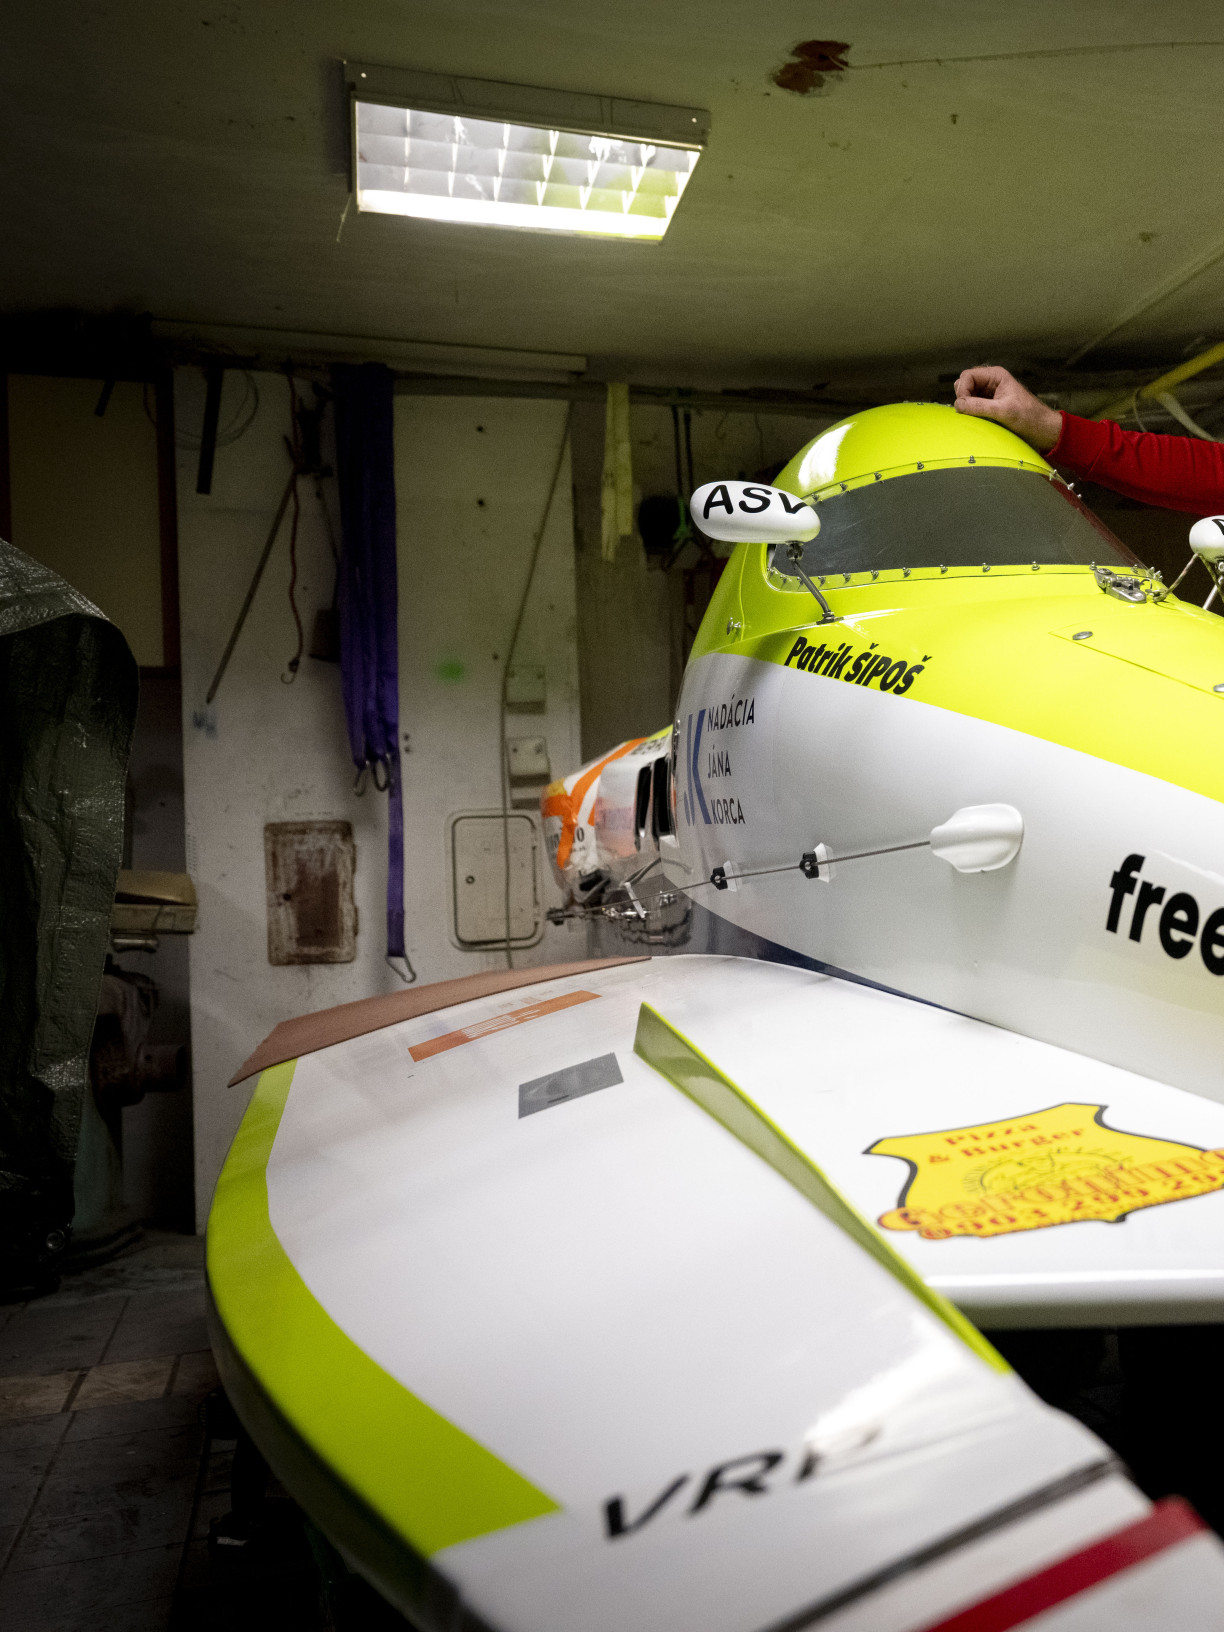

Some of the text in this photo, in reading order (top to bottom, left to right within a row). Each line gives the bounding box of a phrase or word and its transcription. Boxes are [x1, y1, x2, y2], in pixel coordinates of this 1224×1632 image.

[784, 636, 933, 695] Patrik ŠIPOŠ
[707, 693, 755, 732] NADÁCIA
[707, 744, 732, 779] JÁNA
[710, 797, 746, 825] KORCA
[945, 1123, 1039, 1146] Pizza
[961, 1128, 1085, 1157] Burger
